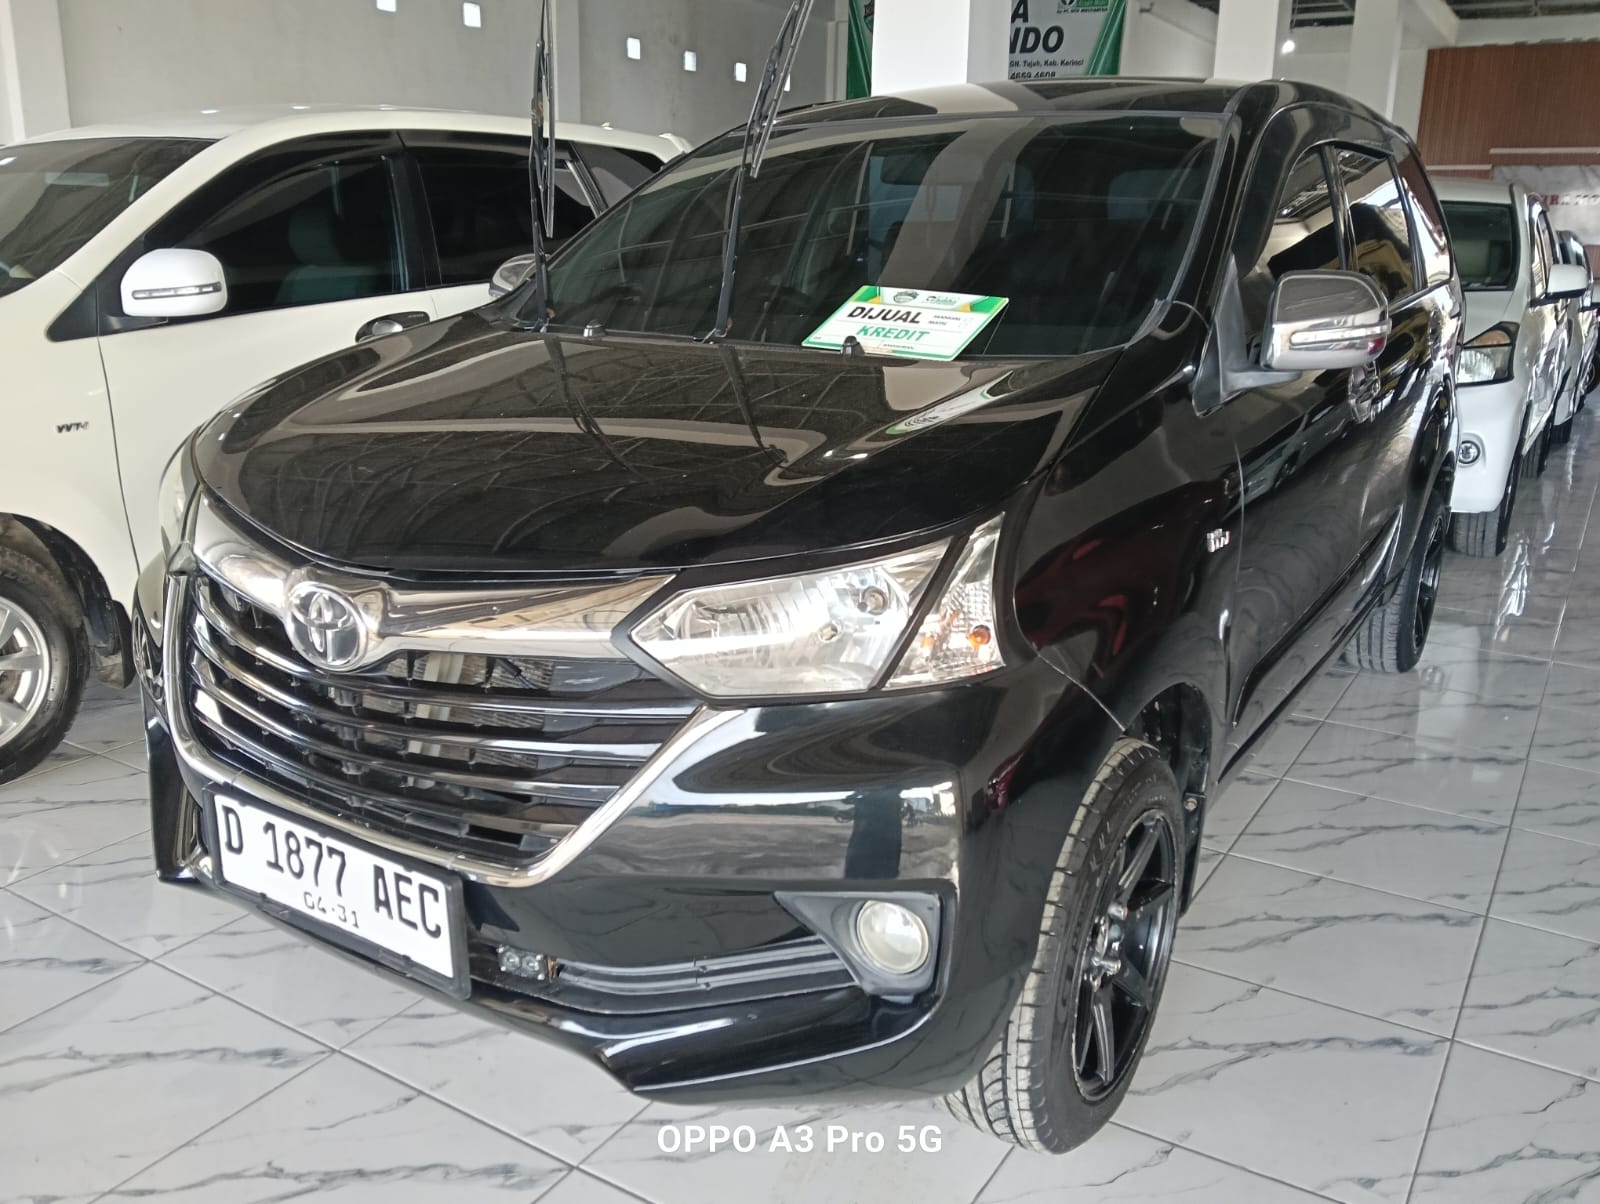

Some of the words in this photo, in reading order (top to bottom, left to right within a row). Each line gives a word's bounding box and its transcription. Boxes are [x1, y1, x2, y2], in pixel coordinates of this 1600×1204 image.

[847, 306, 921, 324] DIJUAL
[856, 325, 930, 341] KREDIT
[222, 805, 244, 855] D
[263, 821, 347, 897] 1877
[373, 864, 442, 939] AEC
